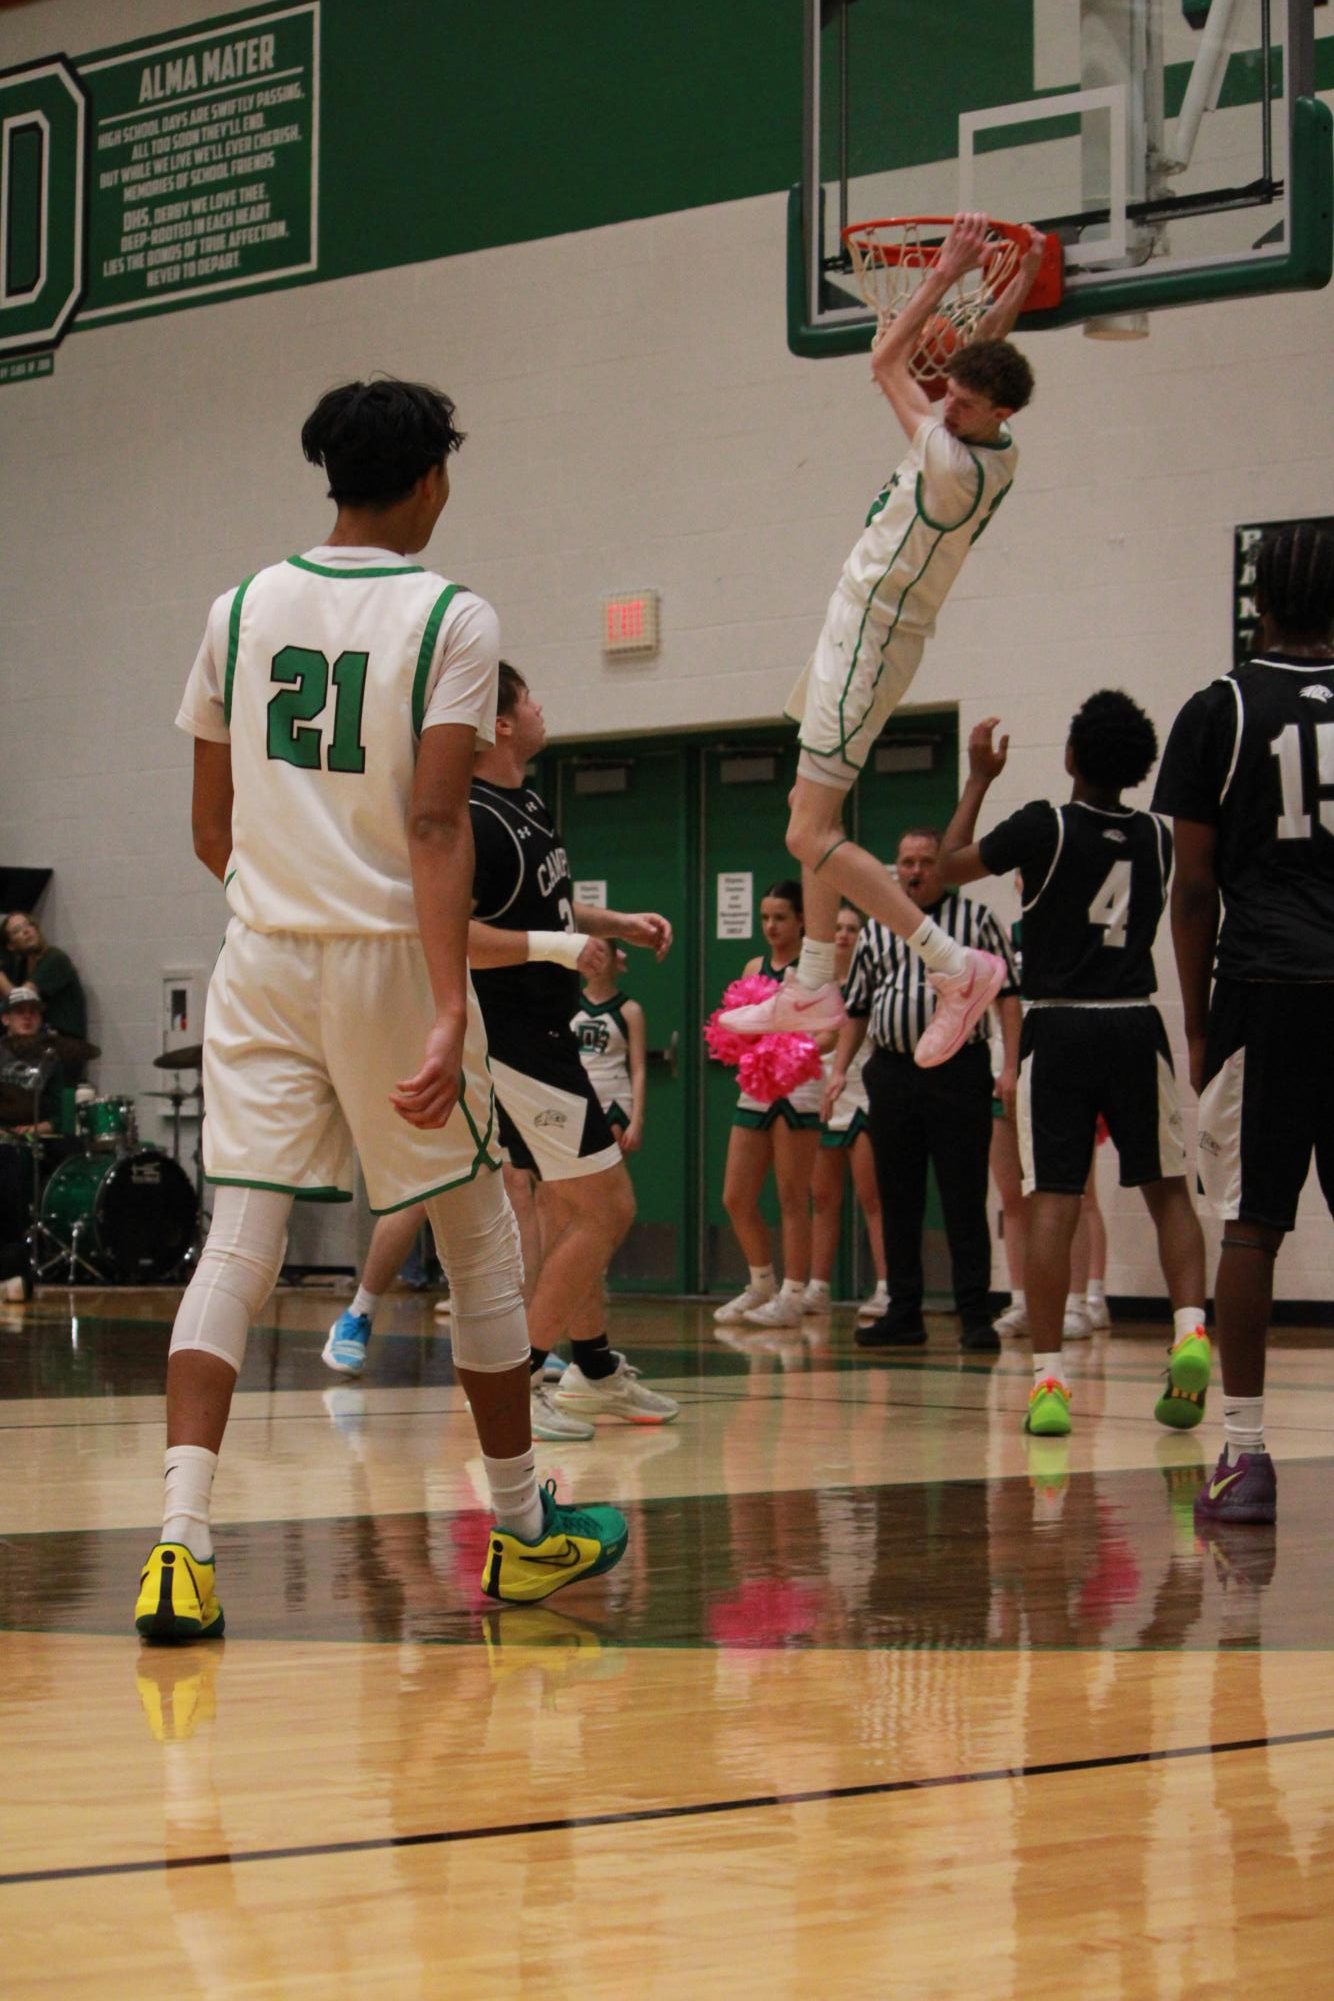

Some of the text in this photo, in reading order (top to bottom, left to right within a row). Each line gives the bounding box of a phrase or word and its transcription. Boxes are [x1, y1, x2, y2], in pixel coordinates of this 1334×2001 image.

[139, 33, 275, 103] ALMA MATER
[98, 130, 121, 149] HIGH
[122, 120, 159, 142] SCHOOL
[162, 112, 188, 131] DAYS
[189, 106, 209, 124] ARE
[211, 94, 255, 119] SWIFTLY
[131, 143, 149, 159] ALL
[151, 137, 170, 153] TOO
[172, 130, 199, 148] SOON
[99, 170, 118, 188] BUT
[120, 162, 151, 182] WHILE
[153, 157, 169, 174] WE
[170, 151, 192, 169] LIVE
[225, 136, 252, 156] EVER
[123, 152, 274, 201] MEMORIES OF SCHOOL FRIENDS
[191, 197, 209, 214] WE
[209, 188, 236, 210] LOVE
[193, 218, 205, 234] IN
[206, 210, 233, 231] EACH
[235, 202, 270, 224] HEART
[103, 257, 125, 276] LIES
[126, 253, 145, 270] THE
[147, 244, 182, 266] BONDS
[182, 240, 197, 258] OF
[200, 234, 226, 253] TRUE
[146, 265, 180, 286] NEVER
[182, 261, 197, 277] TO
[266, 645, 370, 775] 21
[1087, 860, 1133, 948] 4
